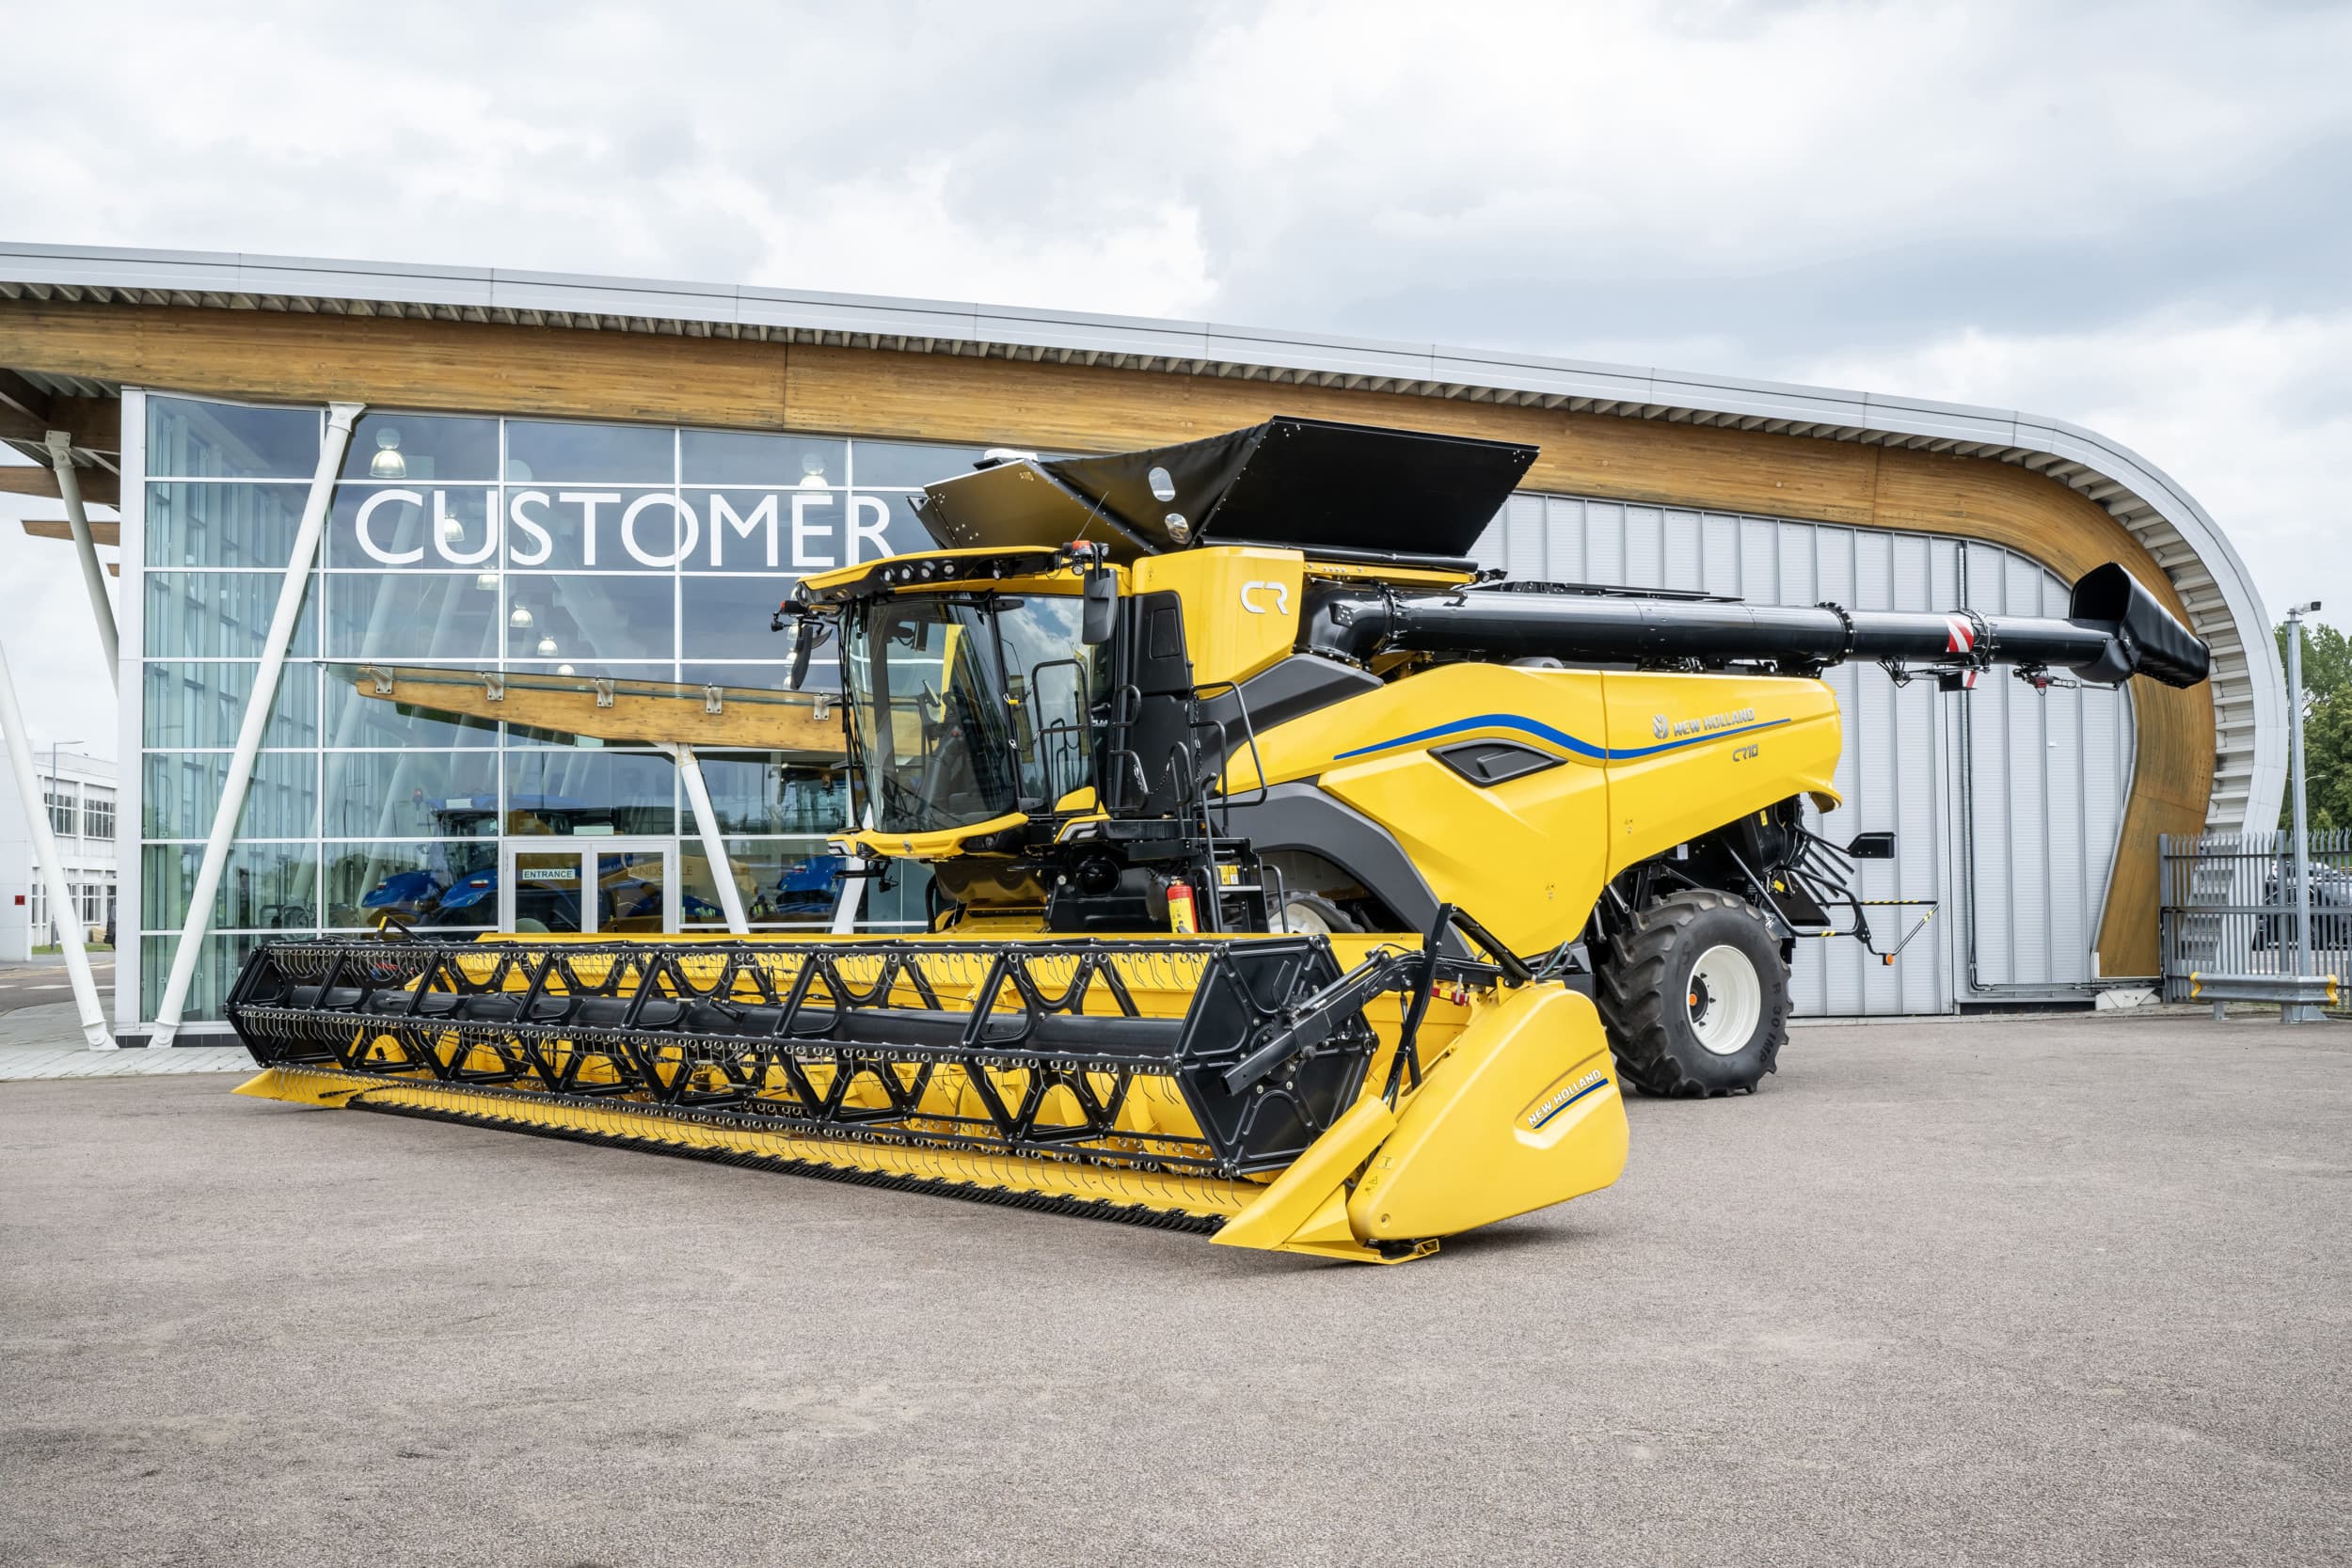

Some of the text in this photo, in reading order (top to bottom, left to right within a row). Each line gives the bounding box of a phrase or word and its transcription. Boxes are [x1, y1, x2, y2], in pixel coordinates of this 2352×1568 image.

[355, 489, 895, 567] CUSTOMER
[1240, 580, 1289, 616] CR
[1674, 707, 1756, 736] NEW HOLLAND
[1732, 743, 1758, 762] CR10
[524, 870, 573, 879] ENTRANCE
[1527, 1069, 1602, 1126] NEW HOLLAND
